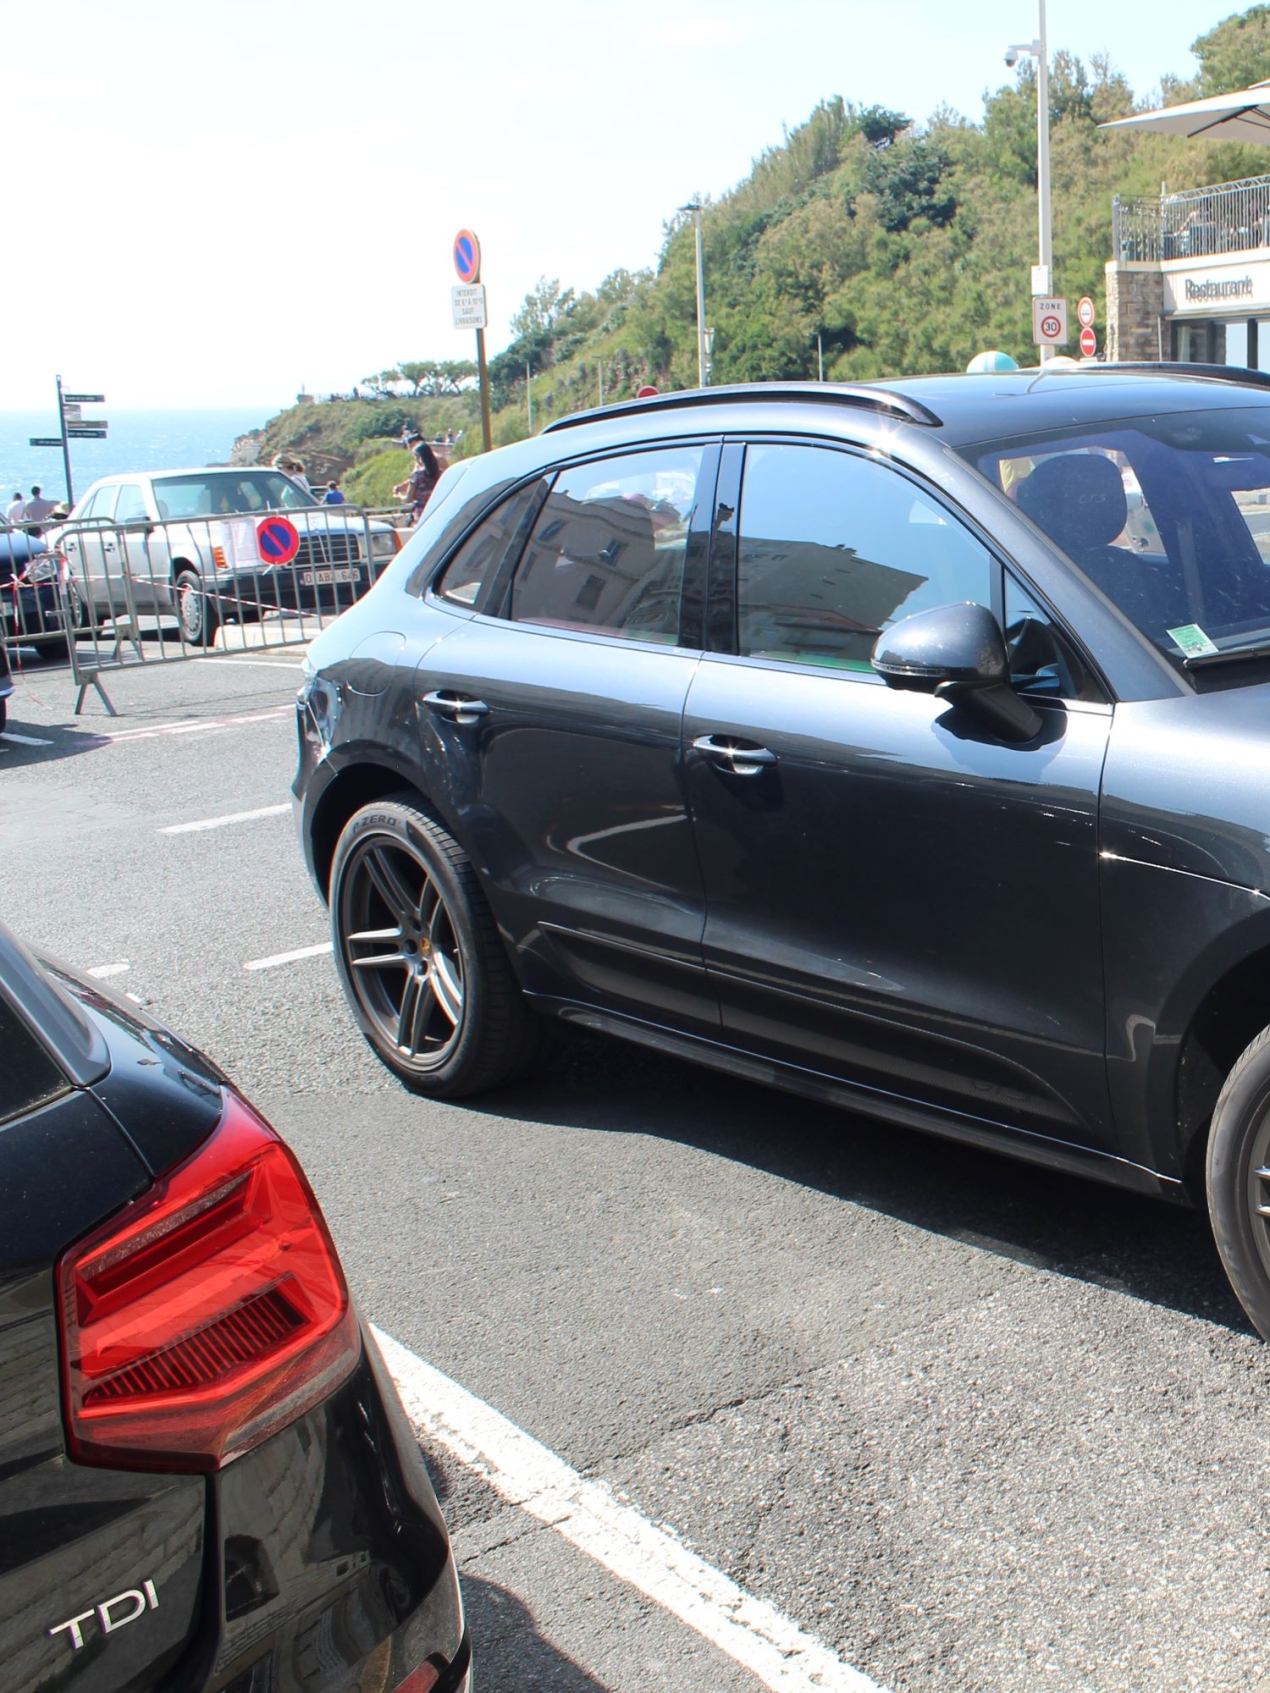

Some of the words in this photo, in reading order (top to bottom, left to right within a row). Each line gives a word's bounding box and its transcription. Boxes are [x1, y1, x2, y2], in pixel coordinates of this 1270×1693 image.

[1185, 275, 1253, 300] Restaurant
[1045, 322, 1058, 332] 30
[45, 1579, 160, 1650] TDI
